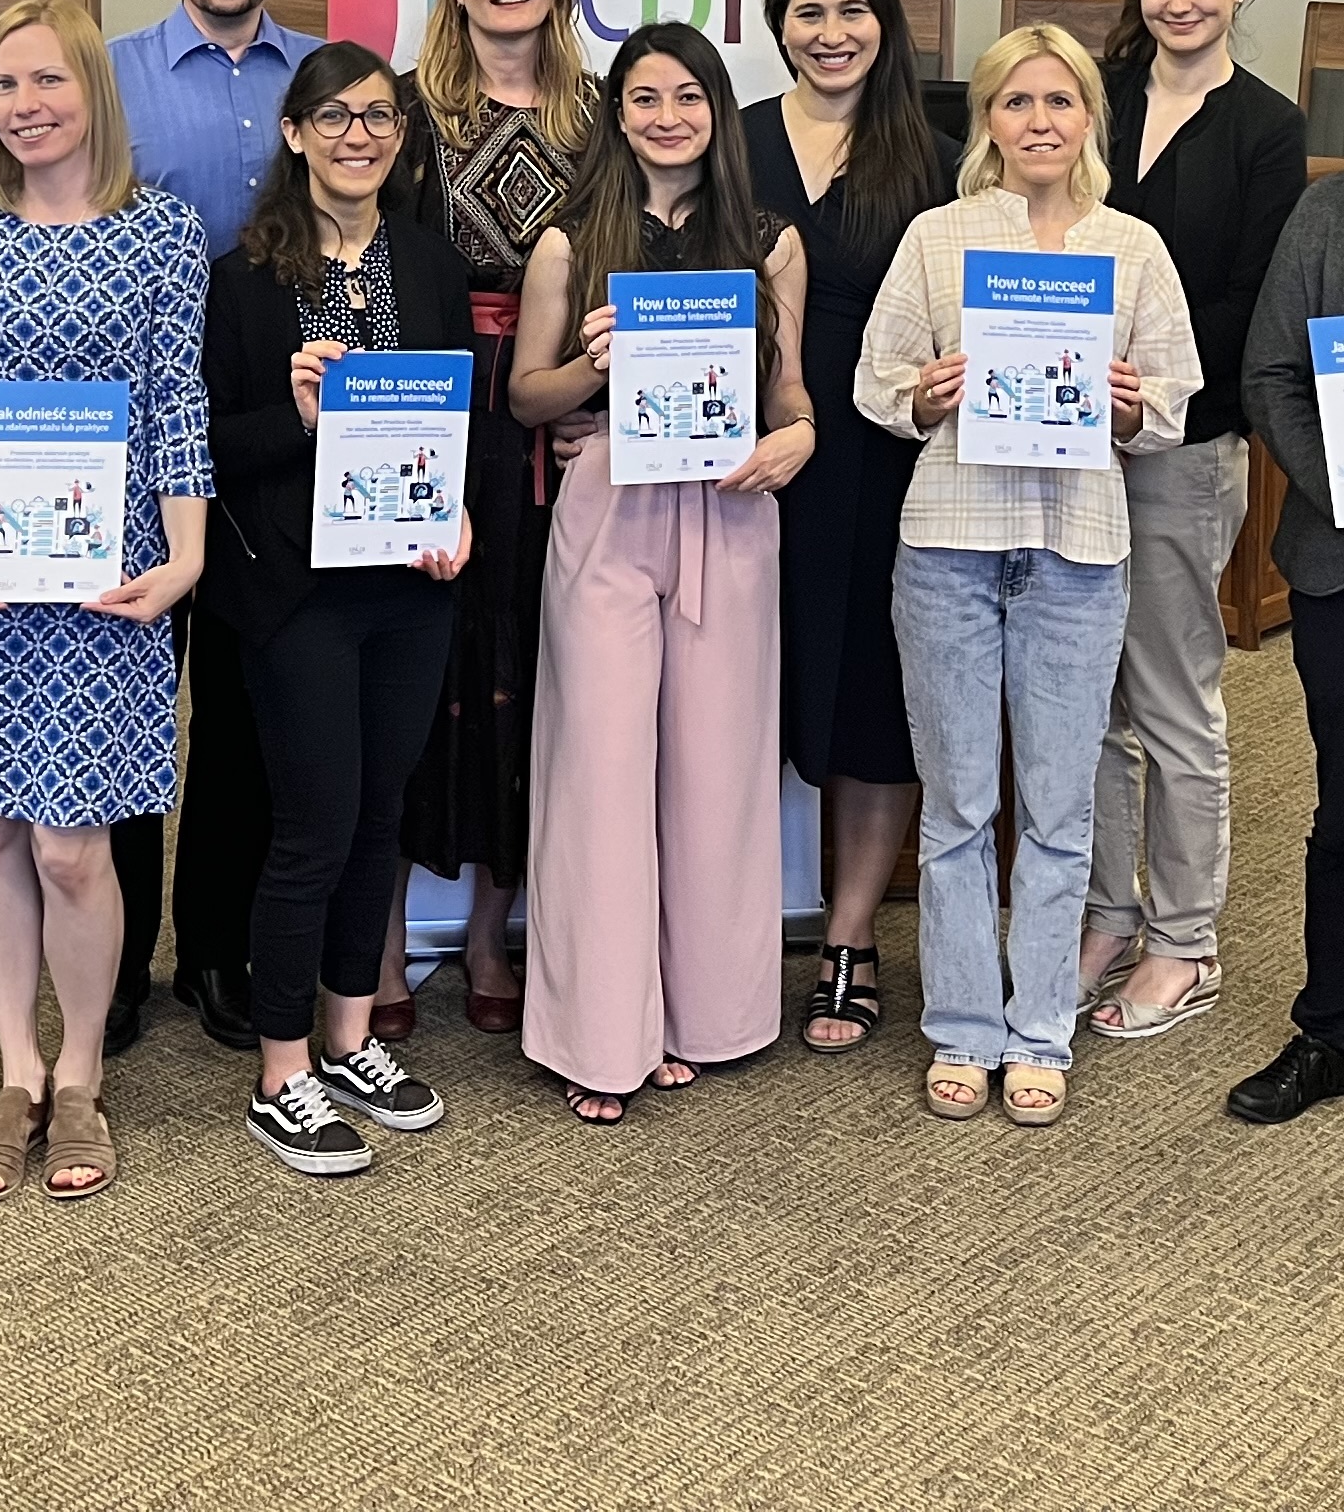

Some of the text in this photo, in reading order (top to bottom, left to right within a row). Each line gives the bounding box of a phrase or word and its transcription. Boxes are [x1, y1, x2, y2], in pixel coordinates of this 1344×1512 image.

[987, 275, 1095, 293] How to succeed
[633, 294, 737, 311] How to succeed
[345, 377, 453, 391] How to succeed
[16, 407, 67, 420] odnieść
[69, 407, 114, 420] sukces
